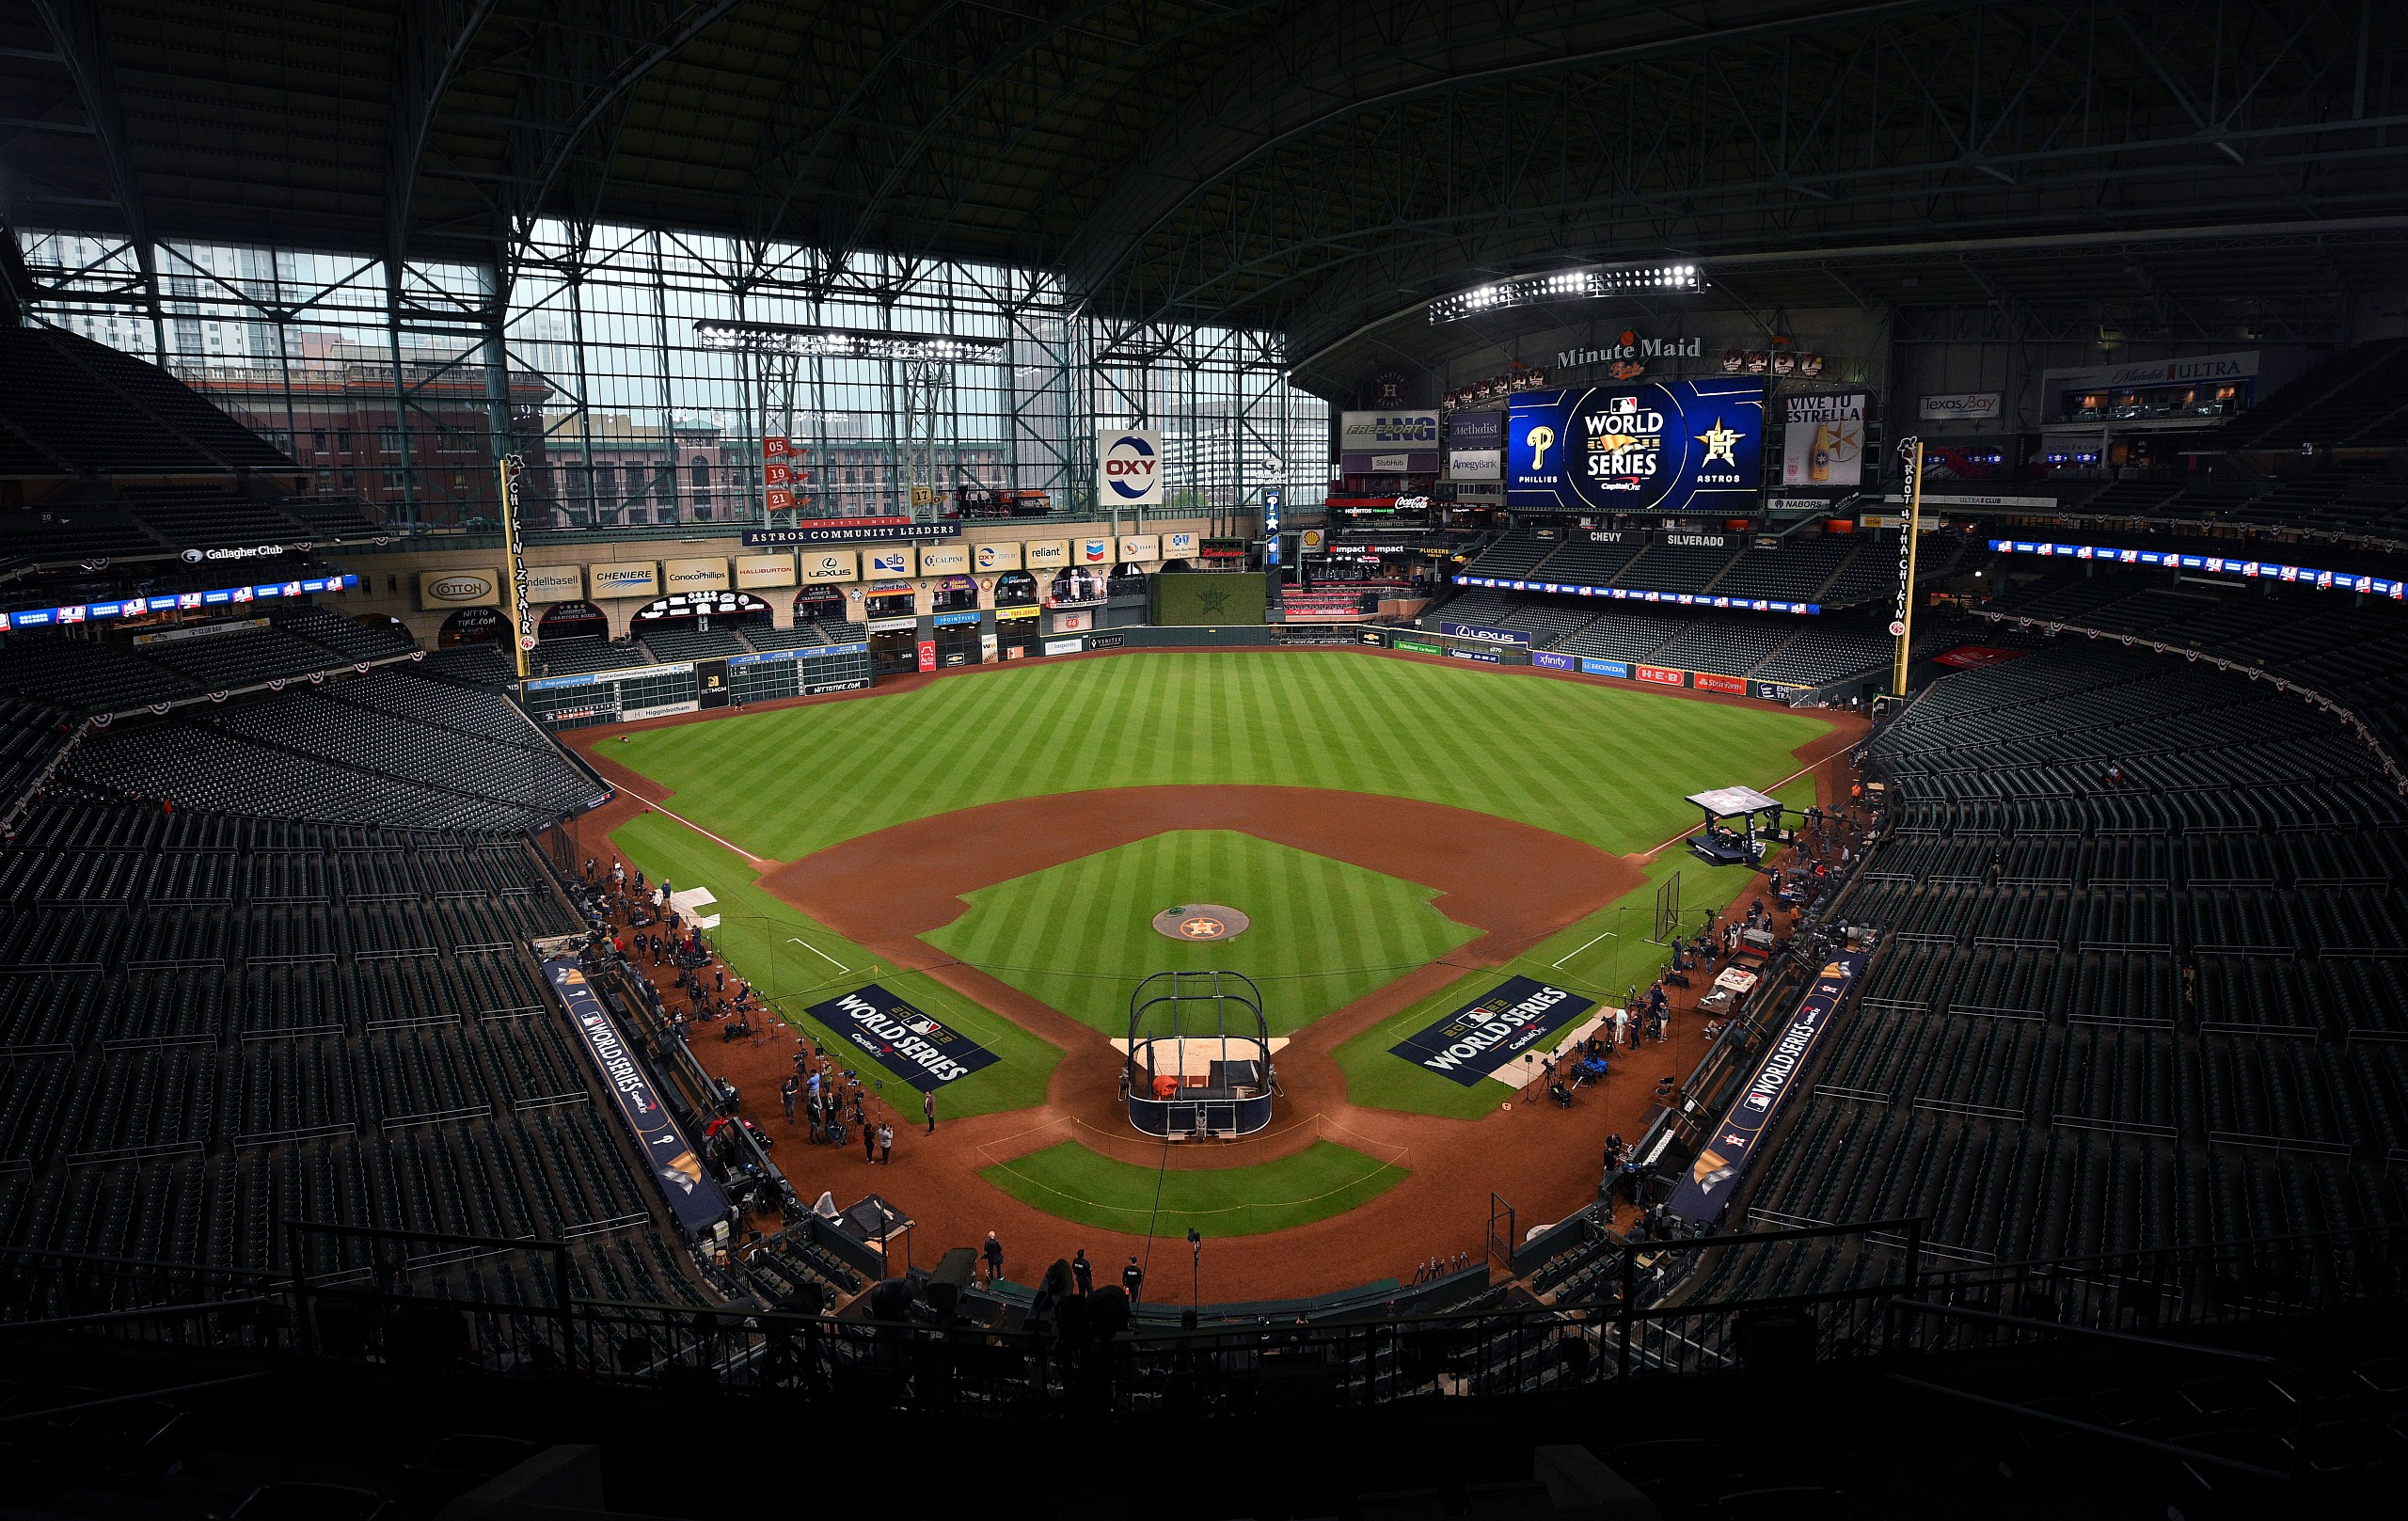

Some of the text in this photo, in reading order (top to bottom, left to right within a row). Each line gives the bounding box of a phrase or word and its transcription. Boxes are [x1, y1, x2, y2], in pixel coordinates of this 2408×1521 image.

[1556, 337, 1703, 370] Minute Maid
[1609, 361, 1645, 377] Park
[2113, 360, 2241, 384] Michelob ULTRA
[1376, 372, 1405, 384] HOUSTON
[1384, 384, 1397, 397] H
[1377, 398, 1403, 408] ASTROS
[1832, 395, 1852, 409] TU
[1925, 395, 1996, 412] Texas Bay
[1346, 423, 1426, 435] FREEPORT
[1376, 417, 1436, 441] LNG
[1453, 423, 1498, 436] Methodist
[1585, 412, 1664, 435] WORLD
[768, 442, 784, 452] 05
[1105, 459, 1157, 475] OXY
[1587, 453, 1656, 476] SERIES
[771, 468, 785, 479] 19
[1697, 475, 1740, 483] ASTROS
[1902, 464, 1914, 505] ROOT
[772, 494, 785, 504] 21
[916, 491, 927, 501] 17
[1395, 496, 1430, 510] Coca-Cola
[509, 482, 523, 555] CHIKIN
[1900, 509, 1910, 520] 4
[811, 528, 895, 540] COMMUNITY
[900, 526, 955, 536] LEADERS
[1590, 531, 1724, 547] CHEVY SILVERADO
[1899, 524, 1909, 556] THA
[206, 546, 283, 561] Gallagher Club
[1032, 547, 1061, 558] reliant
[1201, 547, 1245, 559] Budweiser
[1336, 545, 1404, 554] impact impact
[886, 553, 905, 565] slb
[516, 558, 528, 581] IZ
[596, 570, 653, 580] CHENIERE
[669, 571, 725, 581] ConocoPhillips
[739, 566, 792, 575] HALLIBURTON
[808, 568, 851, 578] LEXUS
[436, 582, 483, 595] COTTON
[949, 578, 967, 587] planet
[1894, 559, 1909, 620] CHIKIN
[463, 609, 489, 618] NITTO
[517, 585, 531, 635] FAIR
[457, 617, 496, 627] TIRE.COM
[1470, 631, 1514, 642] LEXUS
[1539, 655, 1566, 668] xfinity
[1590, 663, 1625, 674] HONDA
[1641, 670, 1678, 683] H-E-B
[701, 686, 727, 695] BETMGM
[814, 682, 861, 694] NITTOTIRE.COM
[644, 705, 690, 717] Higginbotham
[1190, 922, 1215, 935] H
[1423, 987, 1568, 1070] WORLD SERIES
[835, 993, 969, 1081] WORLD SERIES
[587, 1022, 644, 1093] WORLD SERIES
[1751, 1022, 1815, 1095] WORLD SERIES
